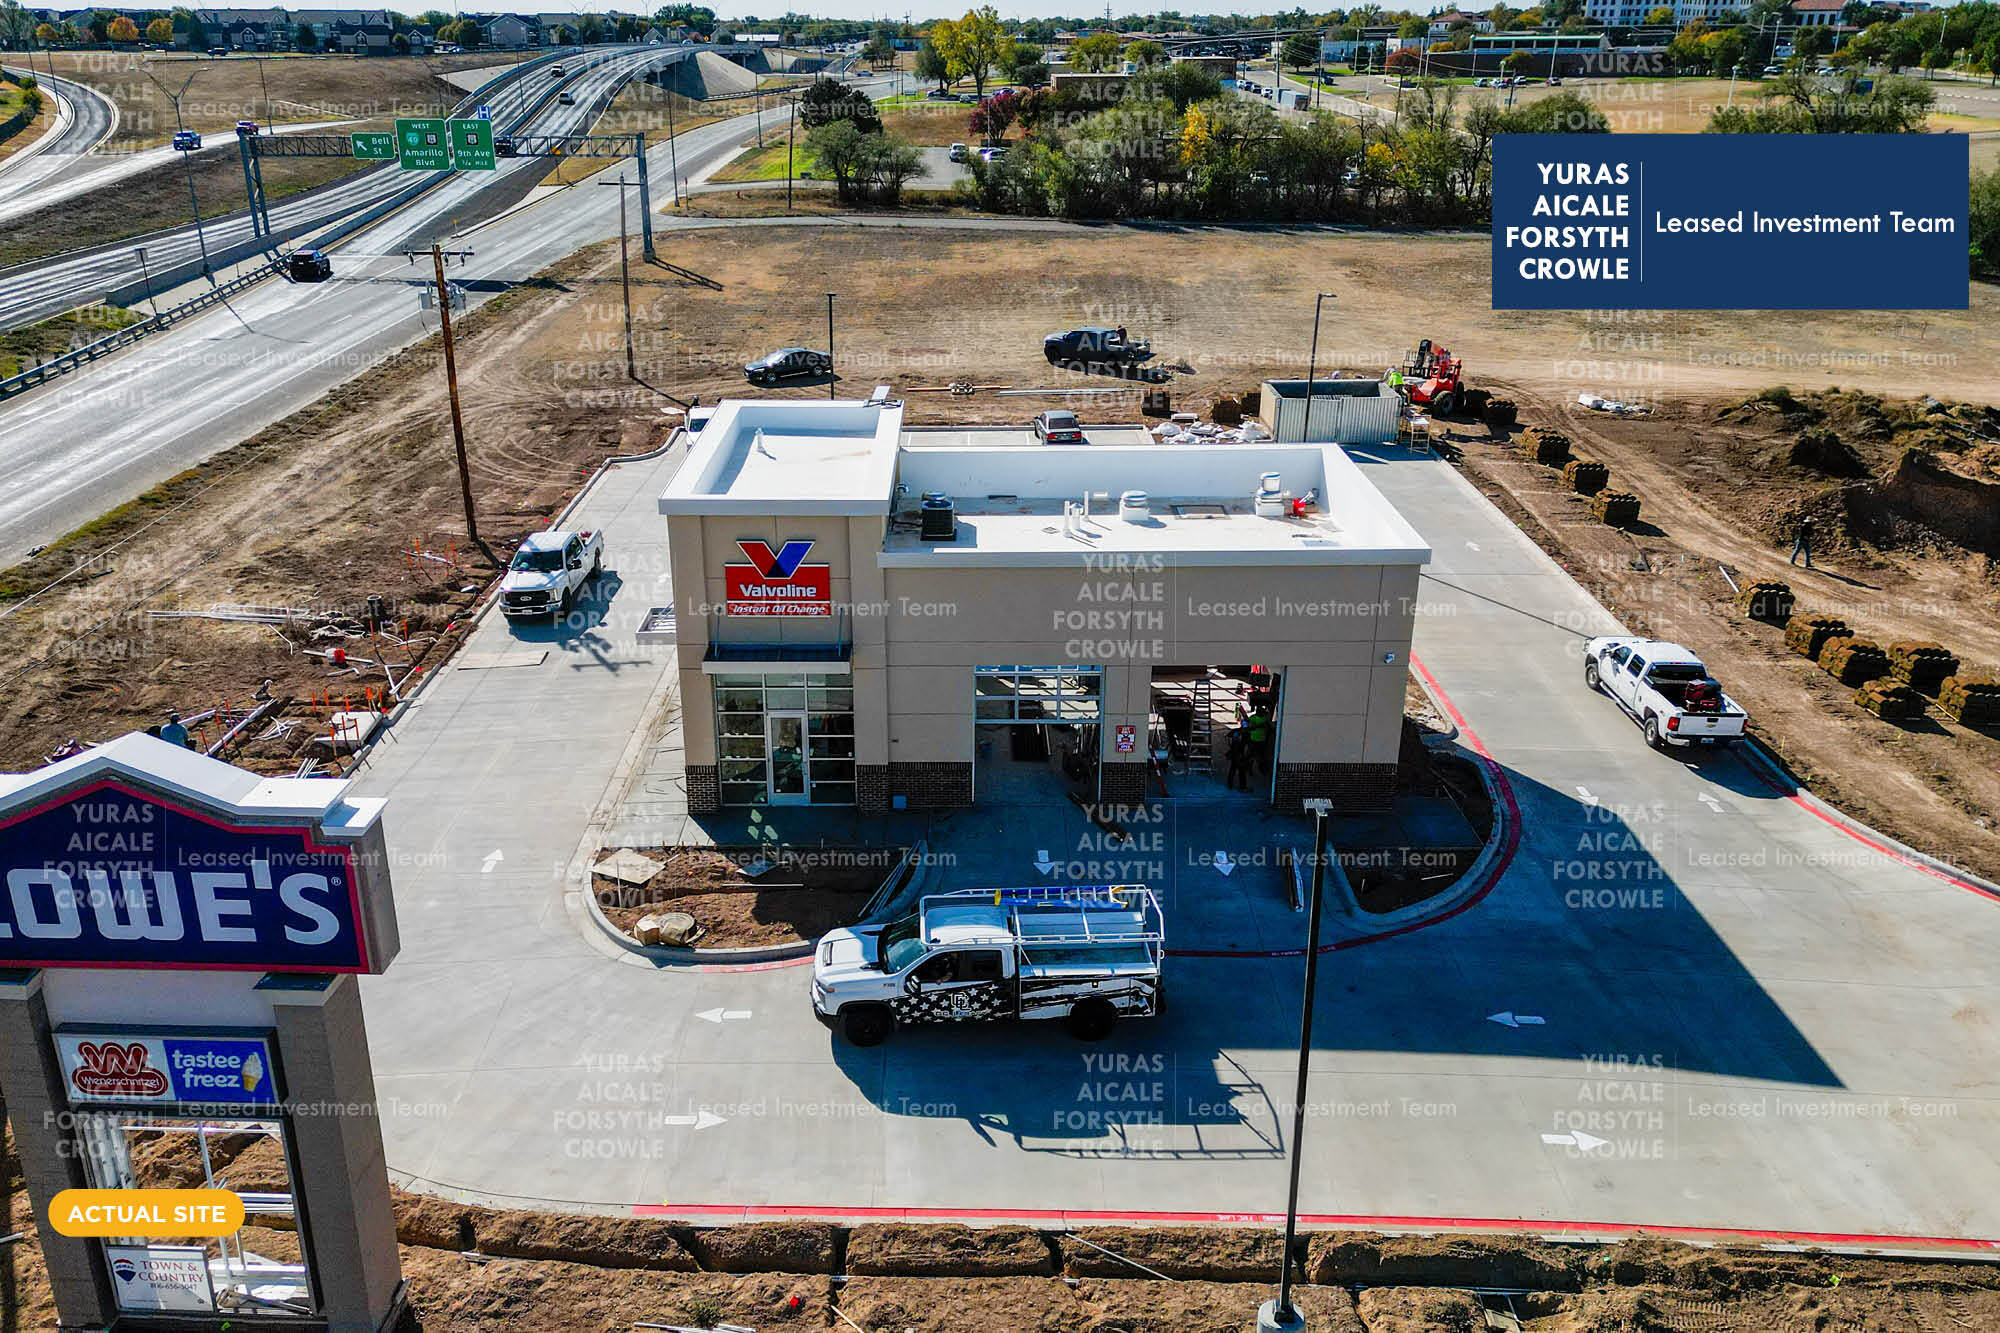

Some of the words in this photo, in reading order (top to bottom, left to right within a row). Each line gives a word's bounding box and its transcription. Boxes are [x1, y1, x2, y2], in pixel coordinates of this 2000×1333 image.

[371, 137, 390, 145] Bell
[405, 149, 444, 157] Amarillo
[739, 584, 817, 597] Valvoline
[733, 605, 770, 613] Instant
[772, 604, 786, 613] Oil
[787, 605, 825, 615] Change
[172, 1050, 241, 1069] tastee
[80, 1075, 160, 1088] Wienerschnitzel
[182, 1072, 240, 1088] freez
[140, 1261, 183, 1271] TOWN
[187, 1263, 198, 1271] &
[138, 1271, 204, 1283] COUNTRY
